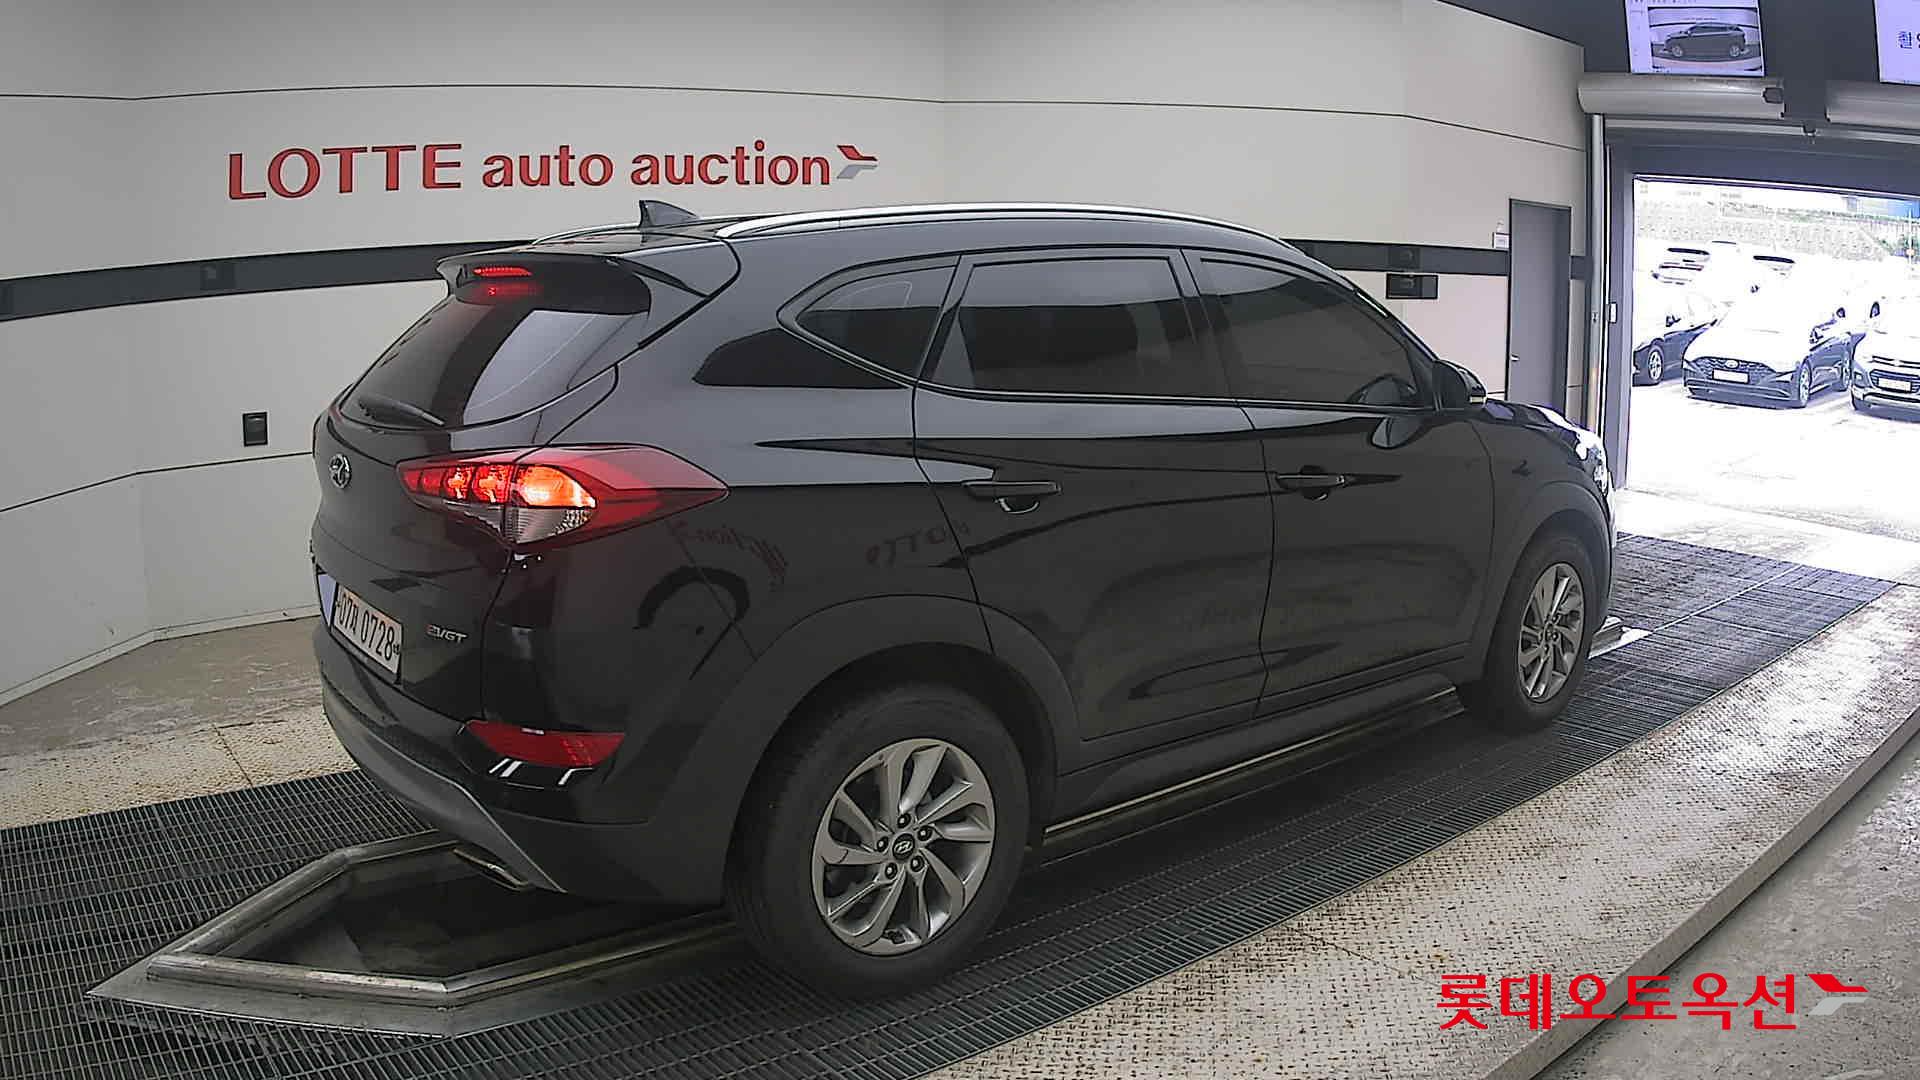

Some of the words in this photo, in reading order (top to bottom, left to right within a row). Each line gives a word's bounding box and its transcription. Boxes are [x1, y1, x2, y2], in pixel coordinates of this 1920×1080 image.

[228, 144, 462, 199] LOTTE
[482, 145, 613, 187] auto
[630, 139, 829, 186] auction
[361, 609, 395, 662] 0728
